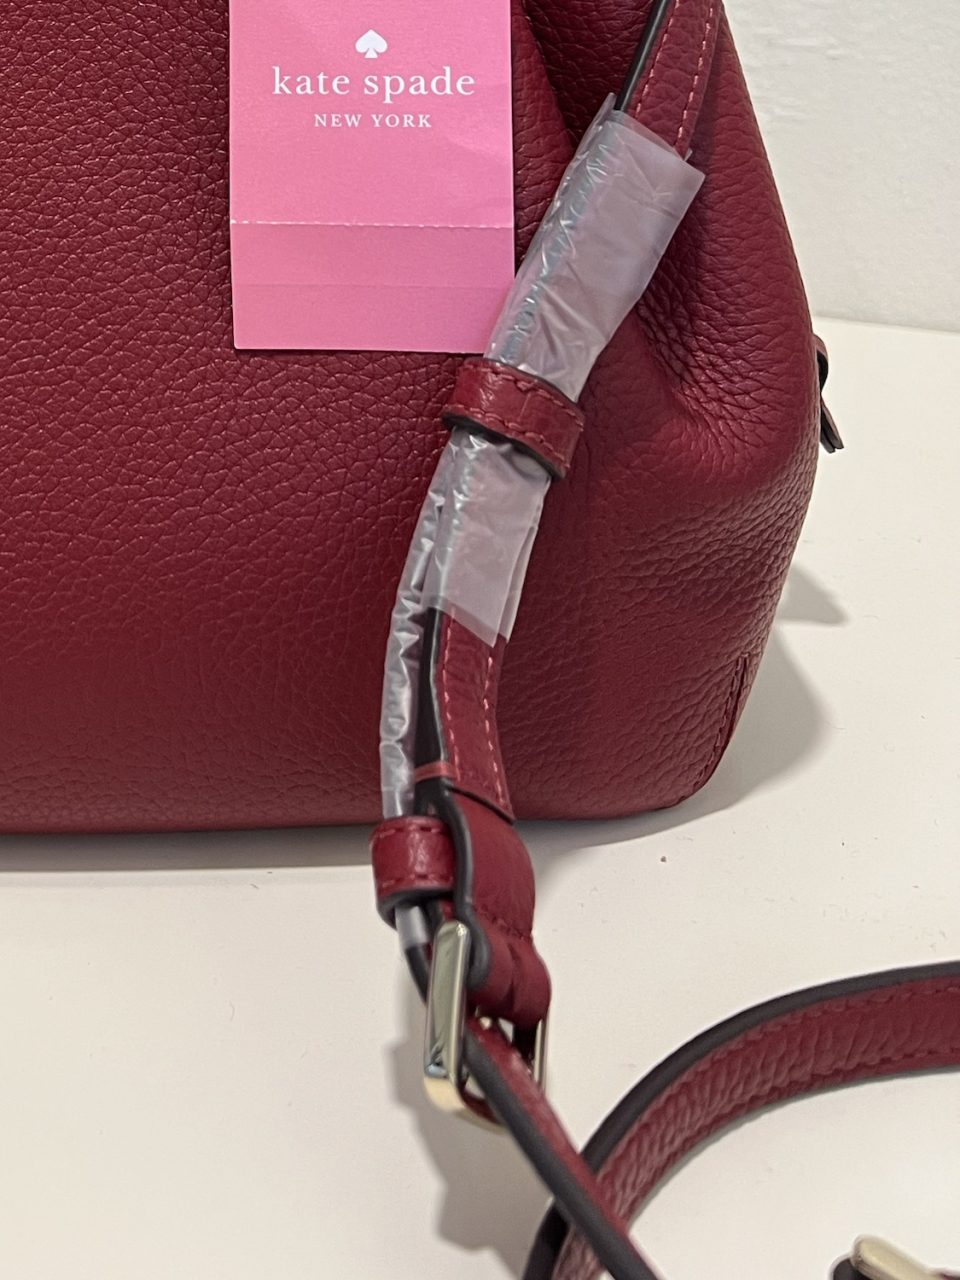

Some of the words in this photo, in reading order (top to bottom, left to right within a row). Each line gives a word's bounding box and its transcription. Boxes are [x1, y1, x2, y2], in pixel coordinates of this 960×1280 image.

[271, 66, 350, 96] kate
[363, 66, 476, 104] spade
[314, 113, 362, 128] NEW
[370, 113, 432, 128] YORK
